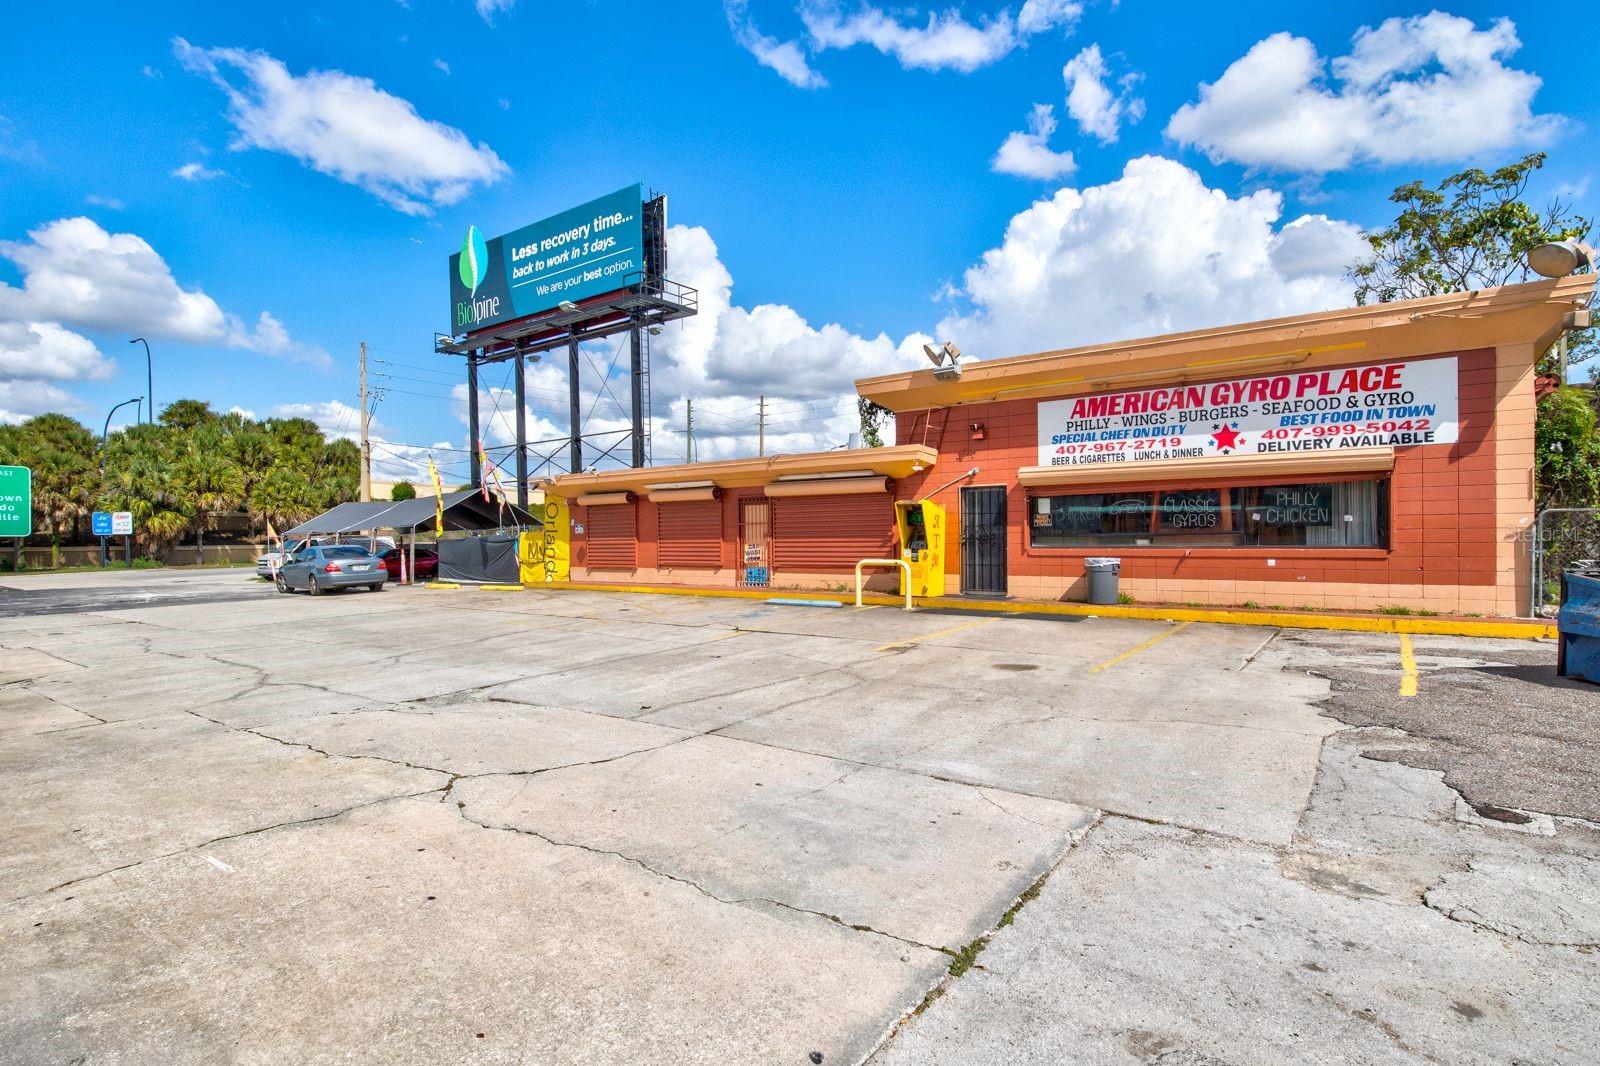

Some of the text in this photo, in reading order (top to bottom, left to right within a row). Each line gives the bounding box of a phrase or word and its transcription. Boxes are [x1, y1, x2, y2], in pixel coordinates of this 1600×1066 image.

[512, 211, 634, 262] Less recovery time...
[512, 236, 616, 279] back to work in 3 days.
[536, 260, 634, 296] We are your best option.
[457, 295, 500, 326] BioSpine
[1070, 364, 1405, 419] AMERICAN GYRO PLACE
[1066, 418, 1111, 433] PHILLY
[1121, 412, 1167, 428] WINGS
[1178, 405, 1249, 423] BURGERS
[1262, 397, 1341, 415] SEAFOOD
[1346, 395, 1359, 408] &
[1364, 391, 1415, 407] GYRO
[1280, 404, 1436, 427] BEST FOOD IN TOWN
[1052, 424, 1187, 445] SPECIAL CHEF ON DUTY
[1261, 419, 1430, 440] 407-999-5042
[1055, 437, 1182, 455] 407-967-2719
[1258, 431, 1434, 453] DELIVERY AVAILABLE
[1052, 452, 1126, 465] BEER & CIGARETTES
[1134, 447, 1204, 461] LUNCH & DINNER
[1111, 503, 1146, 515] OPEN
[1164, 499, 1215, 512] CLASSIC
[1276, 491, 1319, 506] PHILLY
[1173, 513, 1216, 528] GYROS
[1266, 507, 1328, 523] CHICKEN
